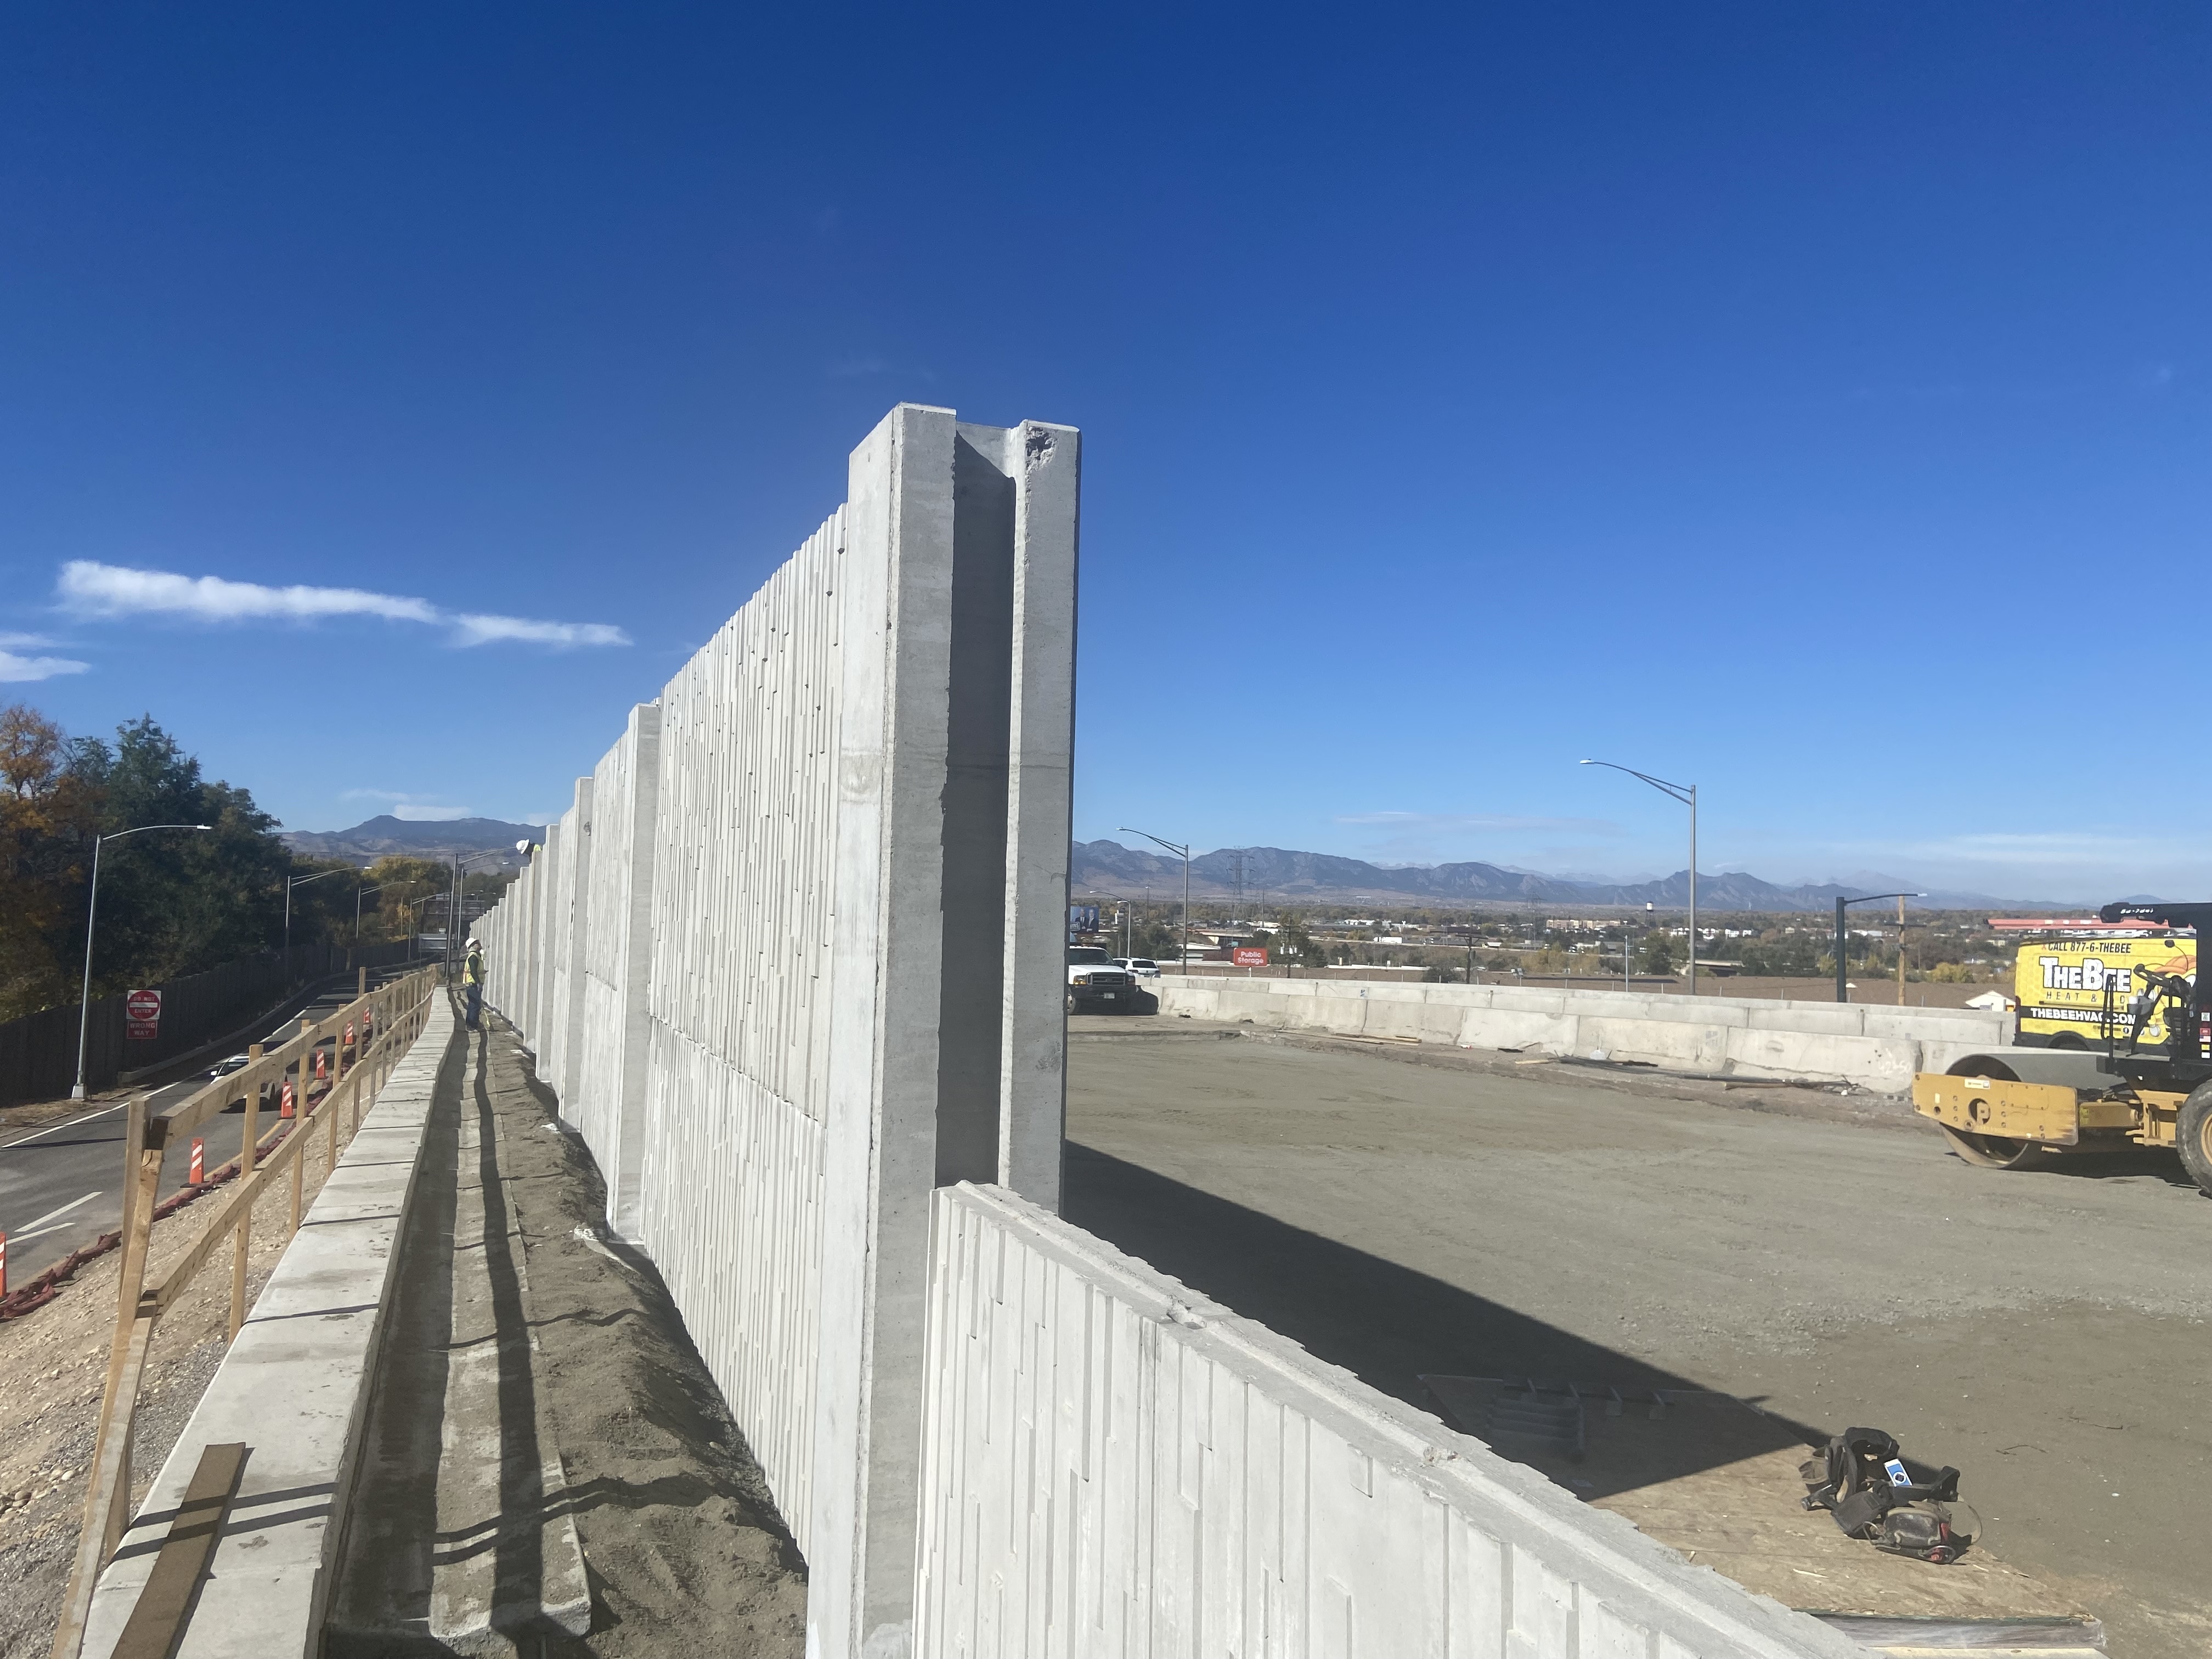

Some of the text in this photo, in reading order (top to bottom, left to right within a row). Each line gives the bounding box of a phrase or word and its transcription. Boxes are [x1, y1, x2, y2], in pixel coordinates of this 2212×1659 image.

[2049, 941, 2132, 953] CALL 877-6-THEBEE
[1238, 957, 1264, 965] Storage
[2046, 991, 2080, 1001] HEAT
